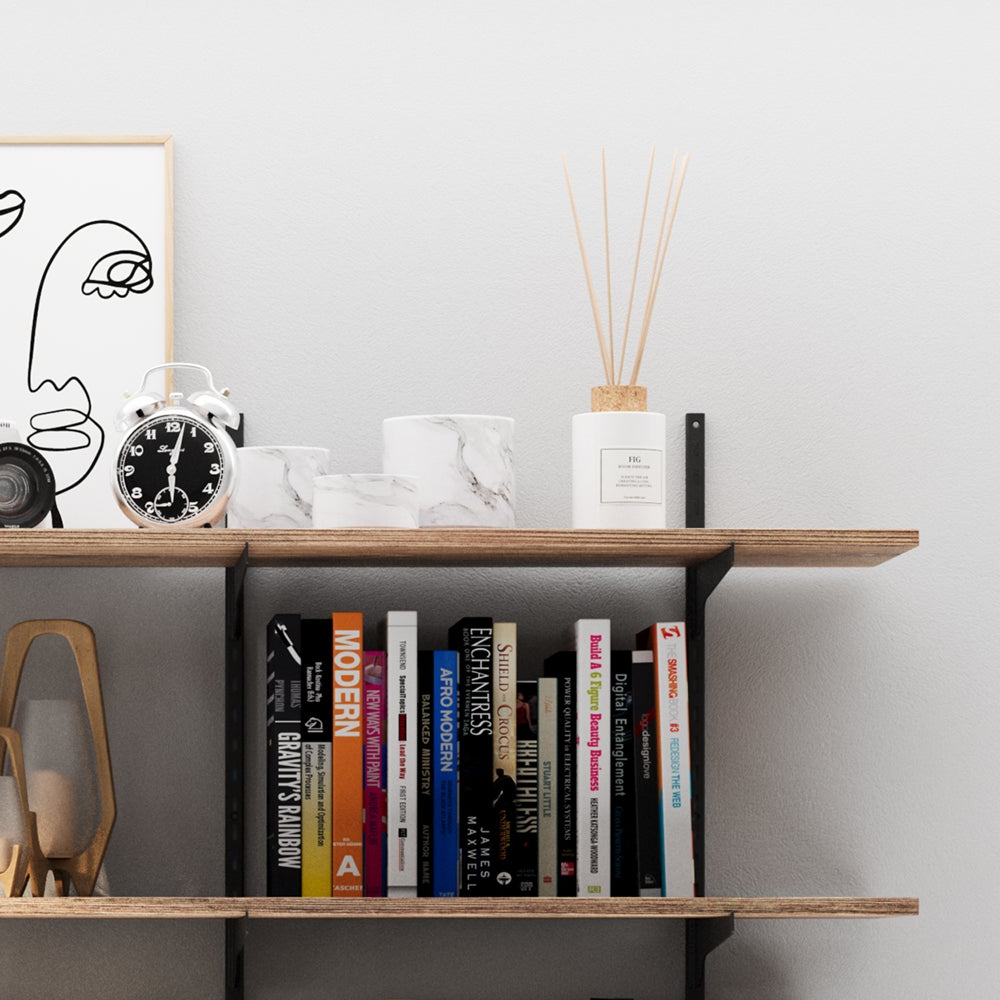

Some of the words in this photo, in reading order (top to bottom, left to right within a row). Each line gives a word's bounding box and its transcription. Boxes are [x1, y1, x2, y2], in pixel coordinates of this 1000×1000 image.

[145, 429, 157, 440] 11
[165, 422, 181, 433] 12
[190, 427, 197, 438] 1
[130, 445, 144, 457] 10
[203, 442, 215, 454] 2
[124, 465, 135, 477] 9
[209, 463, 220, 475] 3
[131, 487, 143, 499] 8
[202, 483, 214, 494] 4
[189, 502, 199, 513] 5
[589, 635, 601, 661] Build
[335, 630, 359, 736] MODERN
[440, 668, 453, 707] AFRO
[470, 628, 492, 735] ENCHANTRESS
[614, 674, 627, 711] Digital
[367, 690, 380, 710] NEW
[587, 681, 601, 711] Figure
[367, 712, 380, 734] WAYS
[421, 695, 430, 744] BALANCED
[587, 713, 601, 748] Beauty
[367, 737, 380, 758] WITH
[440, 710, 453, 772] MODERN
[304, 751, 312, 772] Complex
[590, 750, 601, 791] Business
[613, 719, 627, 796] Entanglement
[317, 772, 325, 799] Simulation
[367, 760, 380, 788] PAINT
[422, 749, 430, 795] MINISTRY
[543, 761, 551, 789] STUART
[317, 801, 325, 811] and
[543, 792, 551, 817] LITTLE
[278, 806, 300, 868] RAINBOW
[316, 812, 325, 846] Optimization
[468, 816, 476, 890] MAXWELL
[480, 827, 489, 878] JAMES
